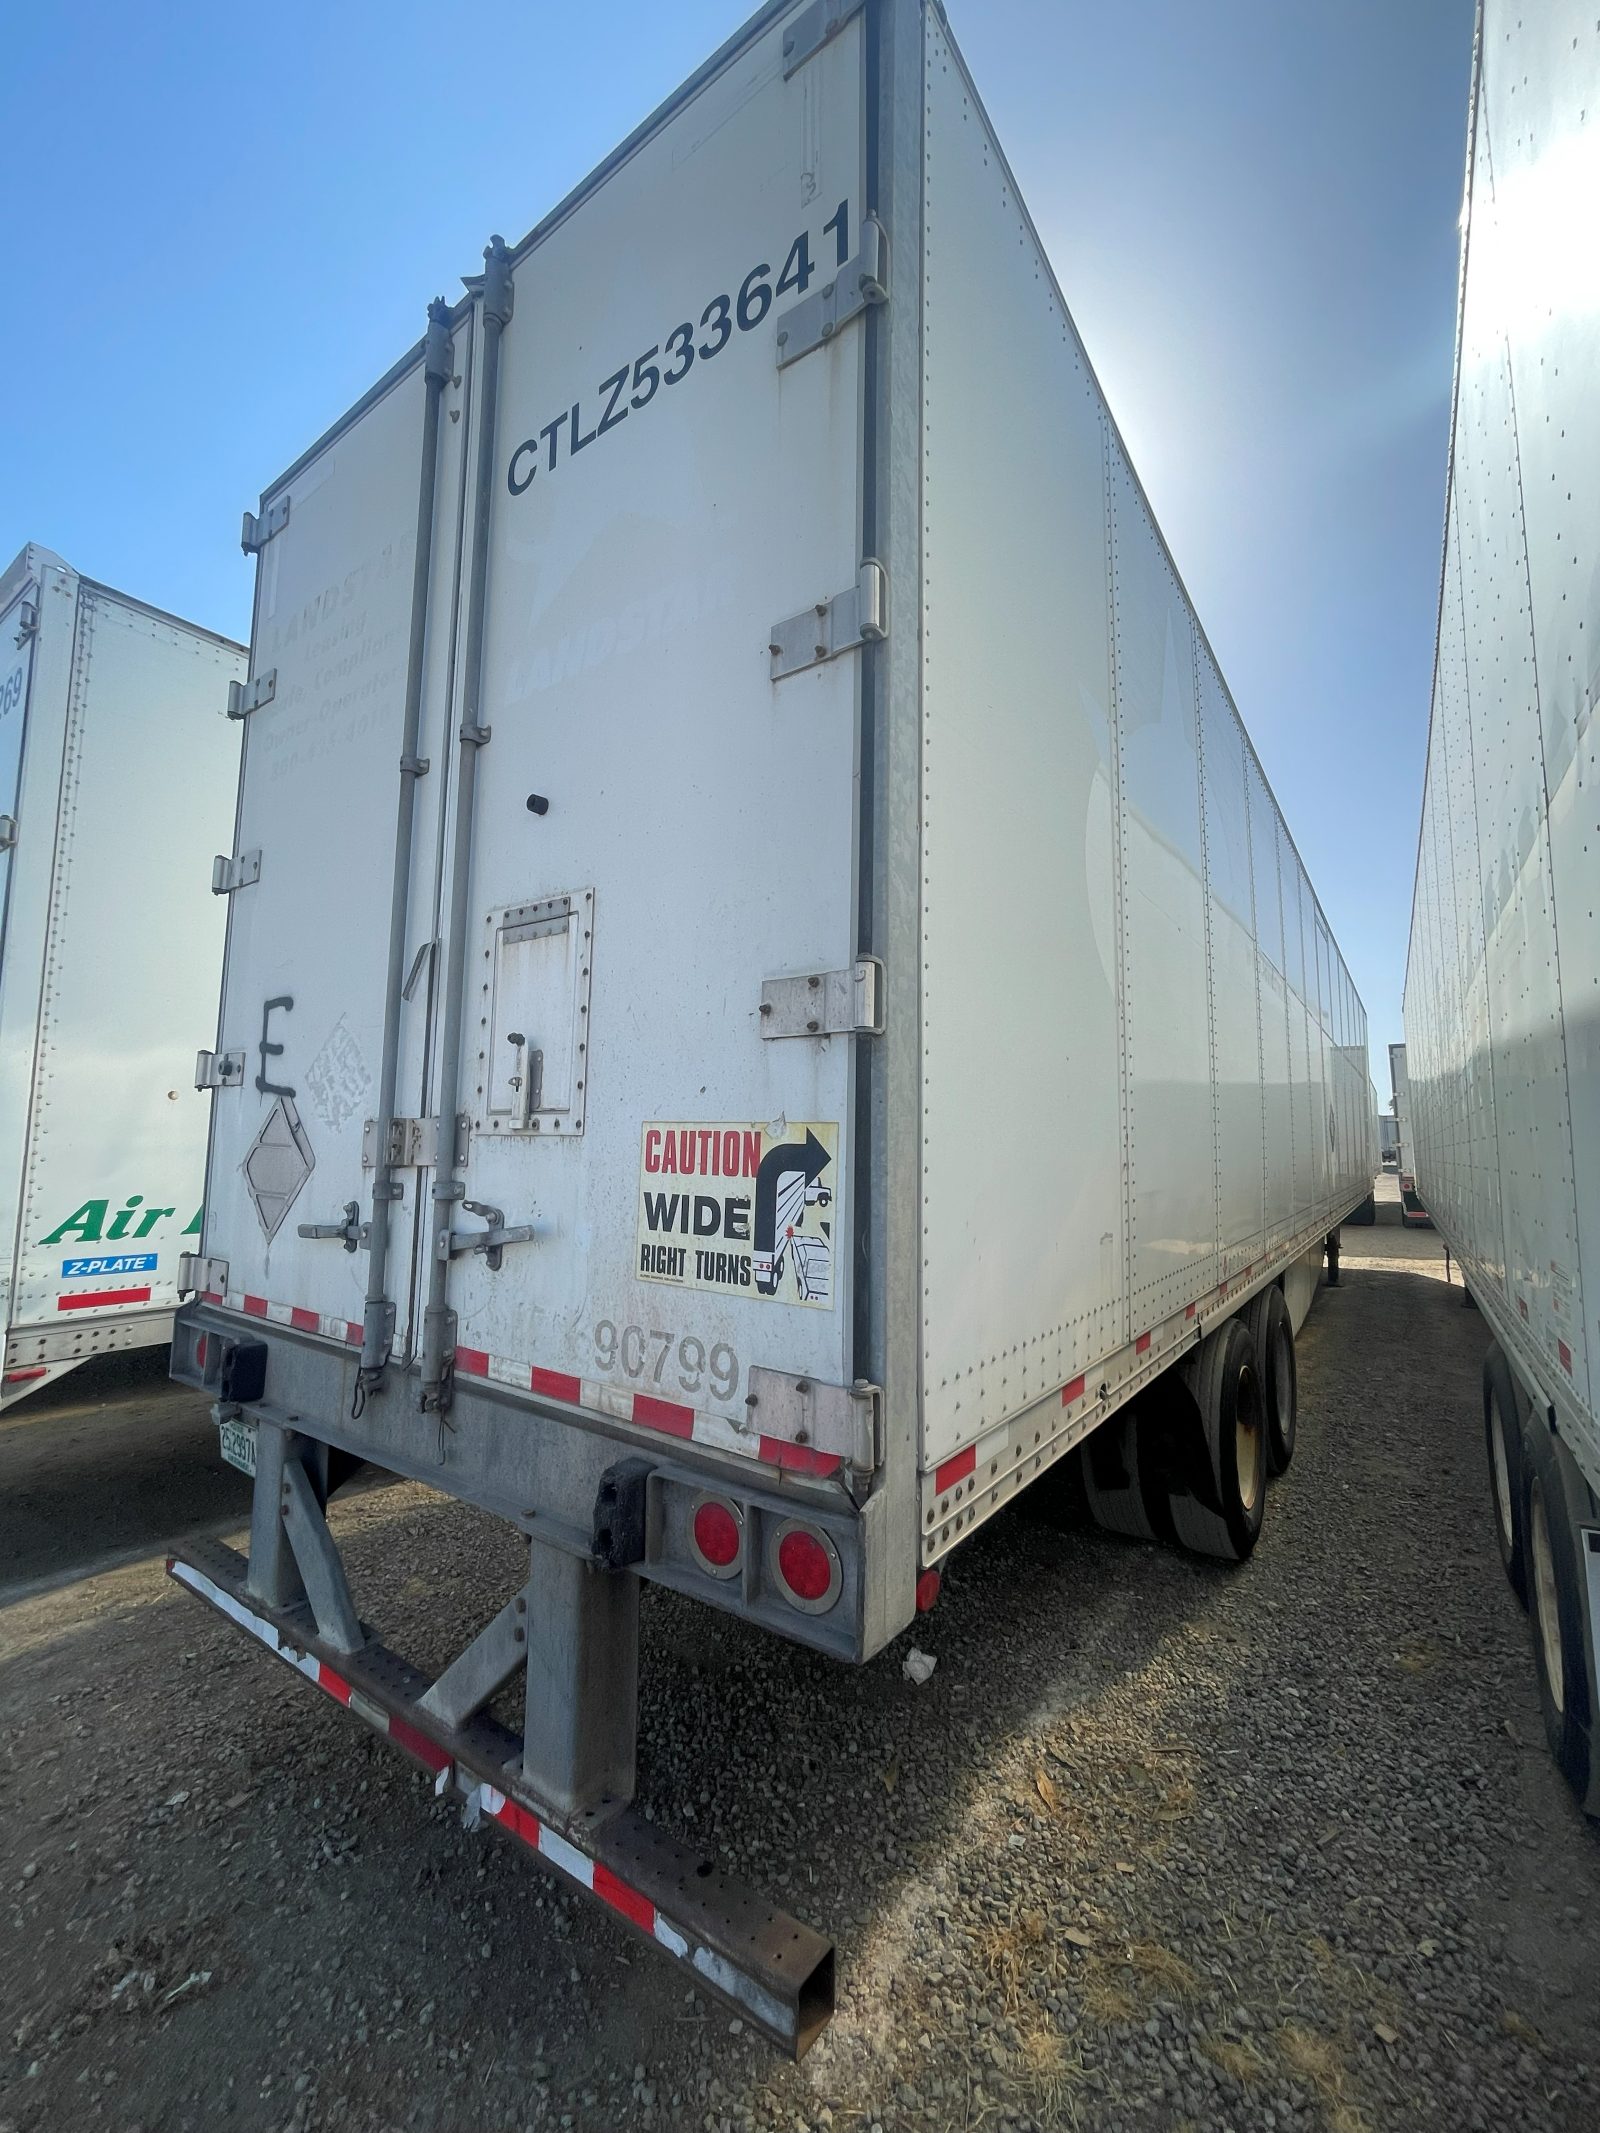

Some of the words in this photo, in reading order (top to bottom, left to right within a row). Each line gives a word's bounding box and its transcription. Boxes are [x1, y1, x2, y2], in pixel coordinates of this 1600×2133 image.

[507, 199, 850, 496] CTLZ533641
[645, 1130, 761, 1178] CAUTION
[38, 1195, 176, 1245] Air
[643, 1191, 751, 1241] WIDE
[68, 1256, 147, 1275] Z-PLATE
[640, 1244, 687, 1277] RIGHT
[695, 1250, 752, 1286] TURNS
[594, 1319, 739, 1401] 90799
